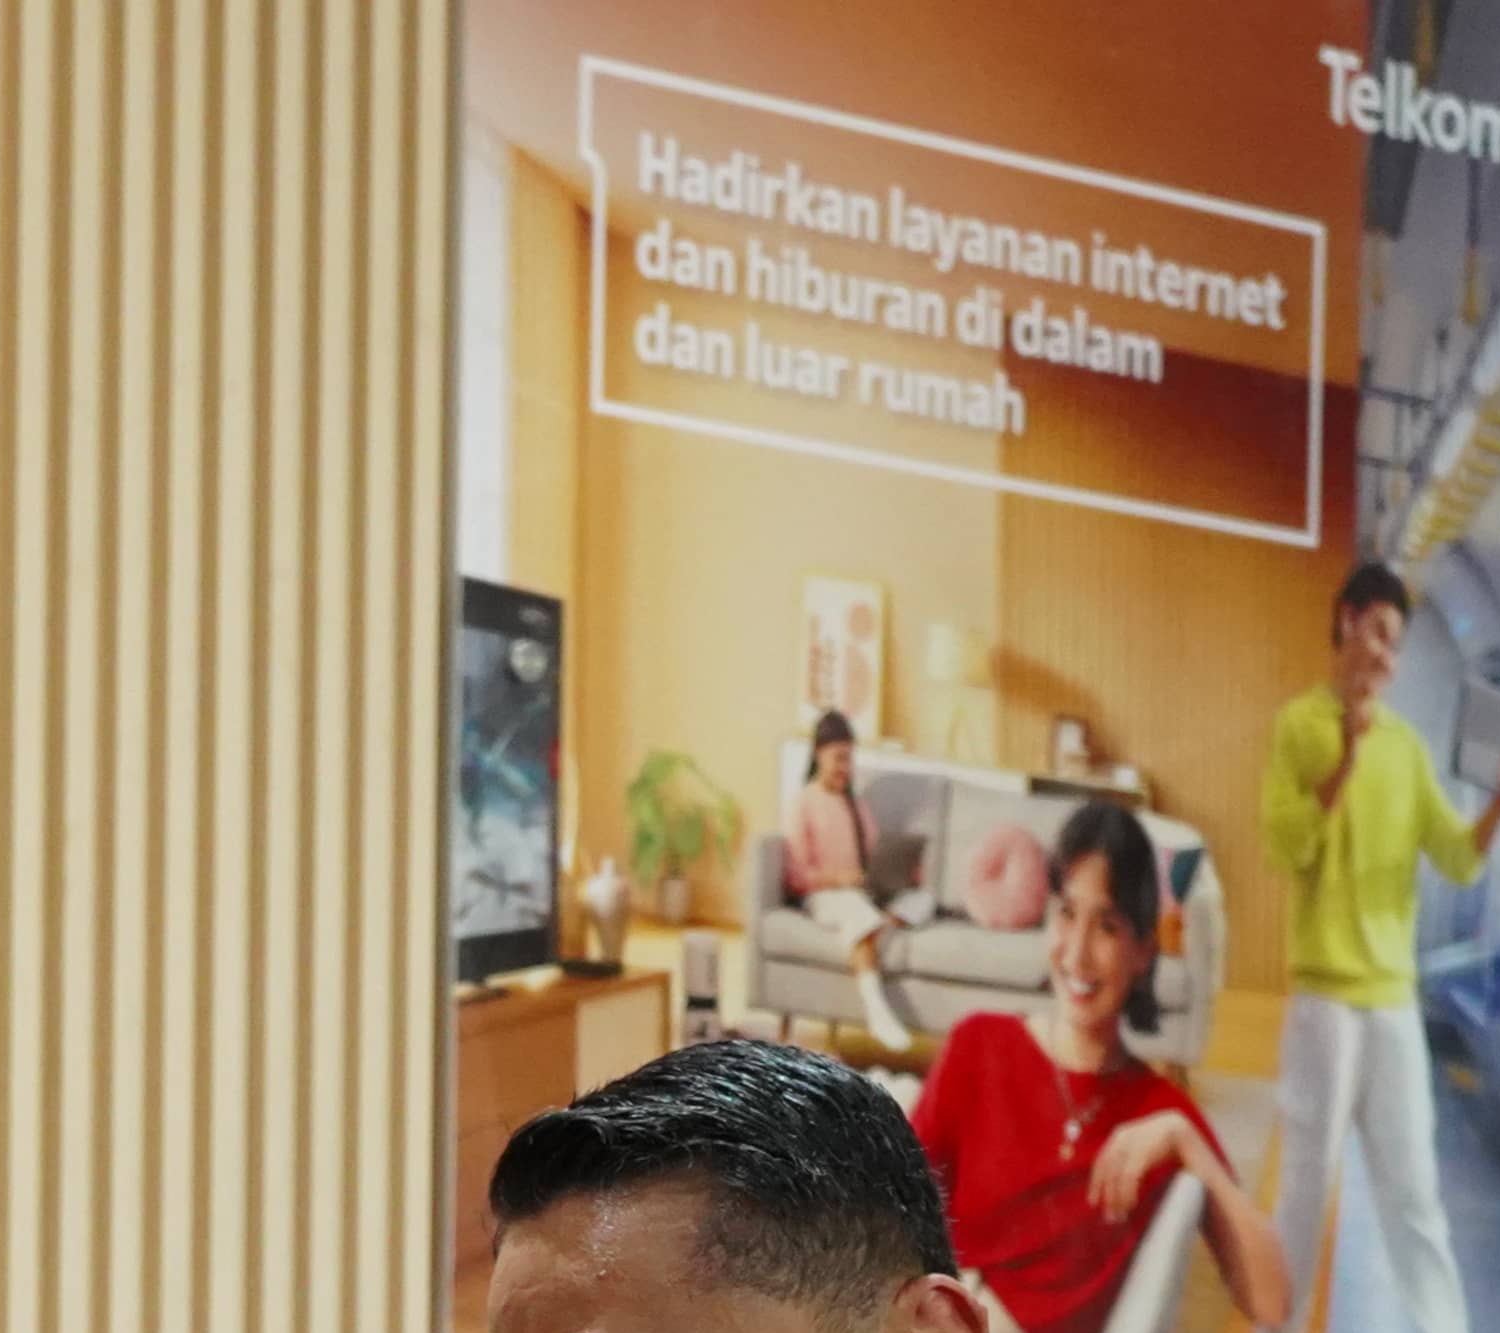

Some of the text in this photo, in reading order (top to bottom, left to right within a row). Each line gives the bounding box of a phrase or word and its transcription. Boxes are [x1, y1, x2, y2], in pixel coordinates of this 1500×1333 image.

[634, 218, 1164, 384] dan hiburan di dalam
[637, 131, 1287, 331] Hadirkan layanan internet
[634, 303, 1026, 434] dan luar rumah
